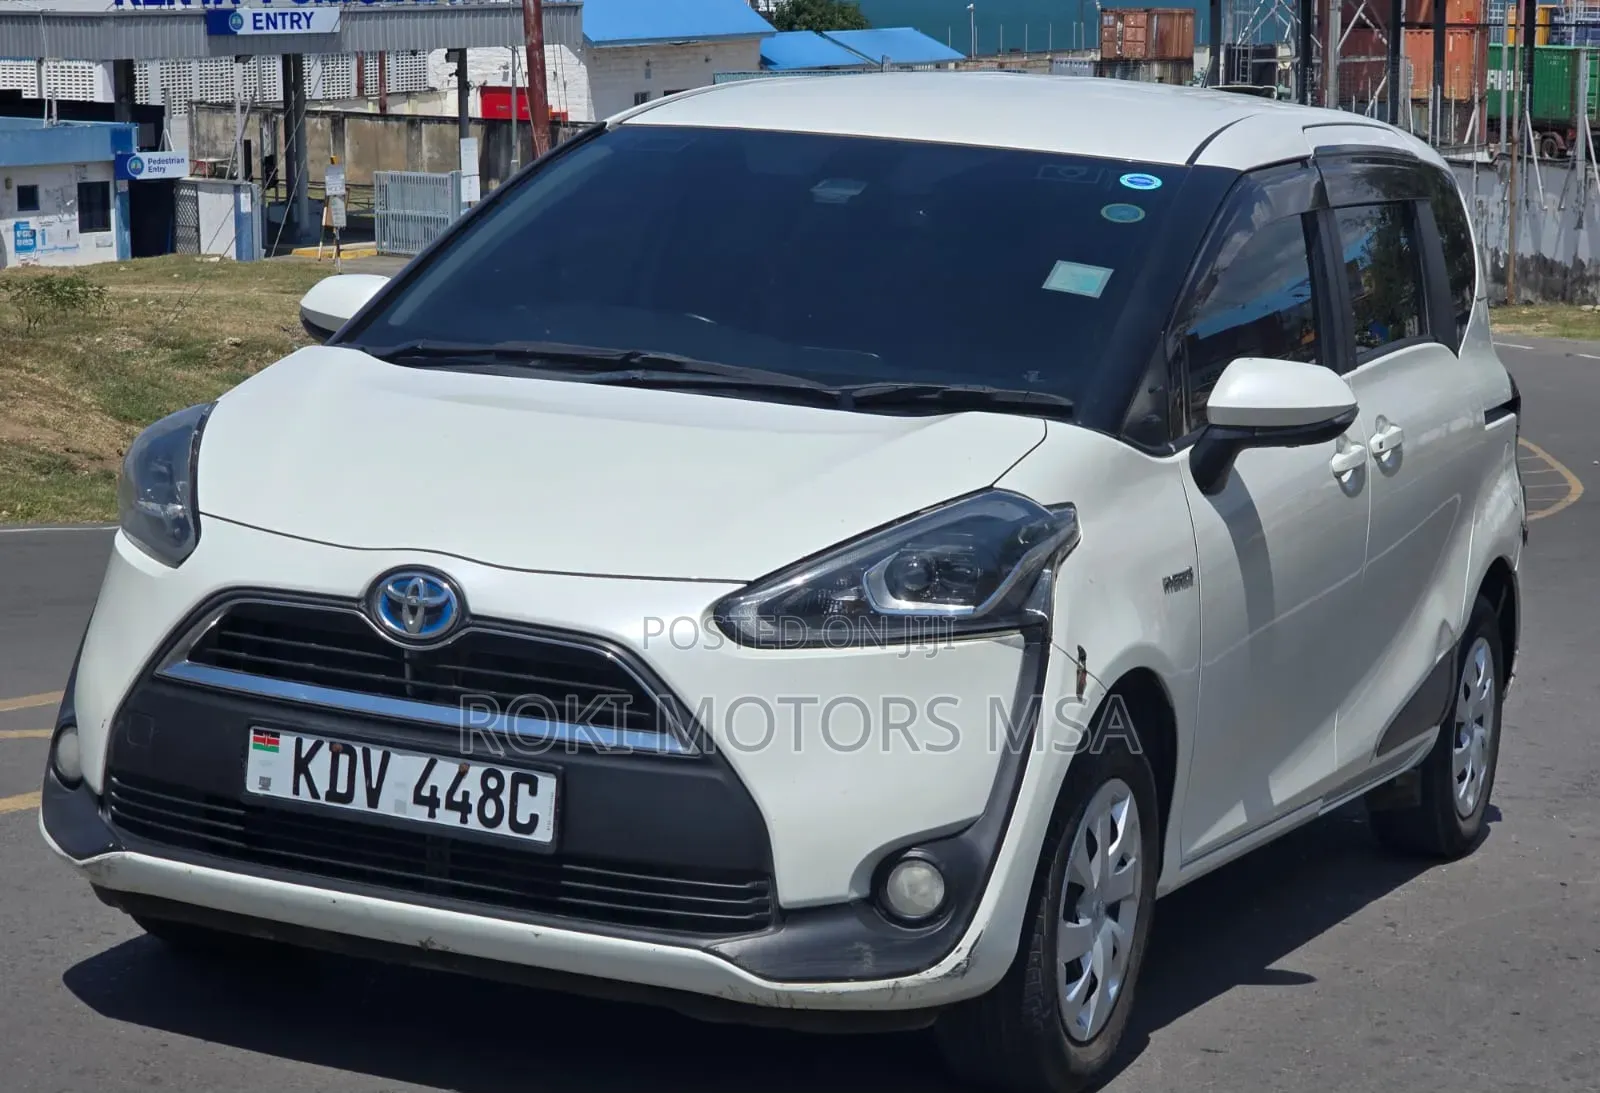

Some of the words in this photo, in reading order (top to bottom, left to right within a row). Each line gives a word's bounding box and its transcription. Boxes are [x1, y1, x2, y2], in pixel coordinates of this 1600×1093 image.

[252, 11, 315, 31] ENTRY
[147, 157, 185, 165] Pedestrian
[147, 166, 167, 174] Entry
[291, 736, 392, 810] KDV
[412, 757, 540, 836] 448C
